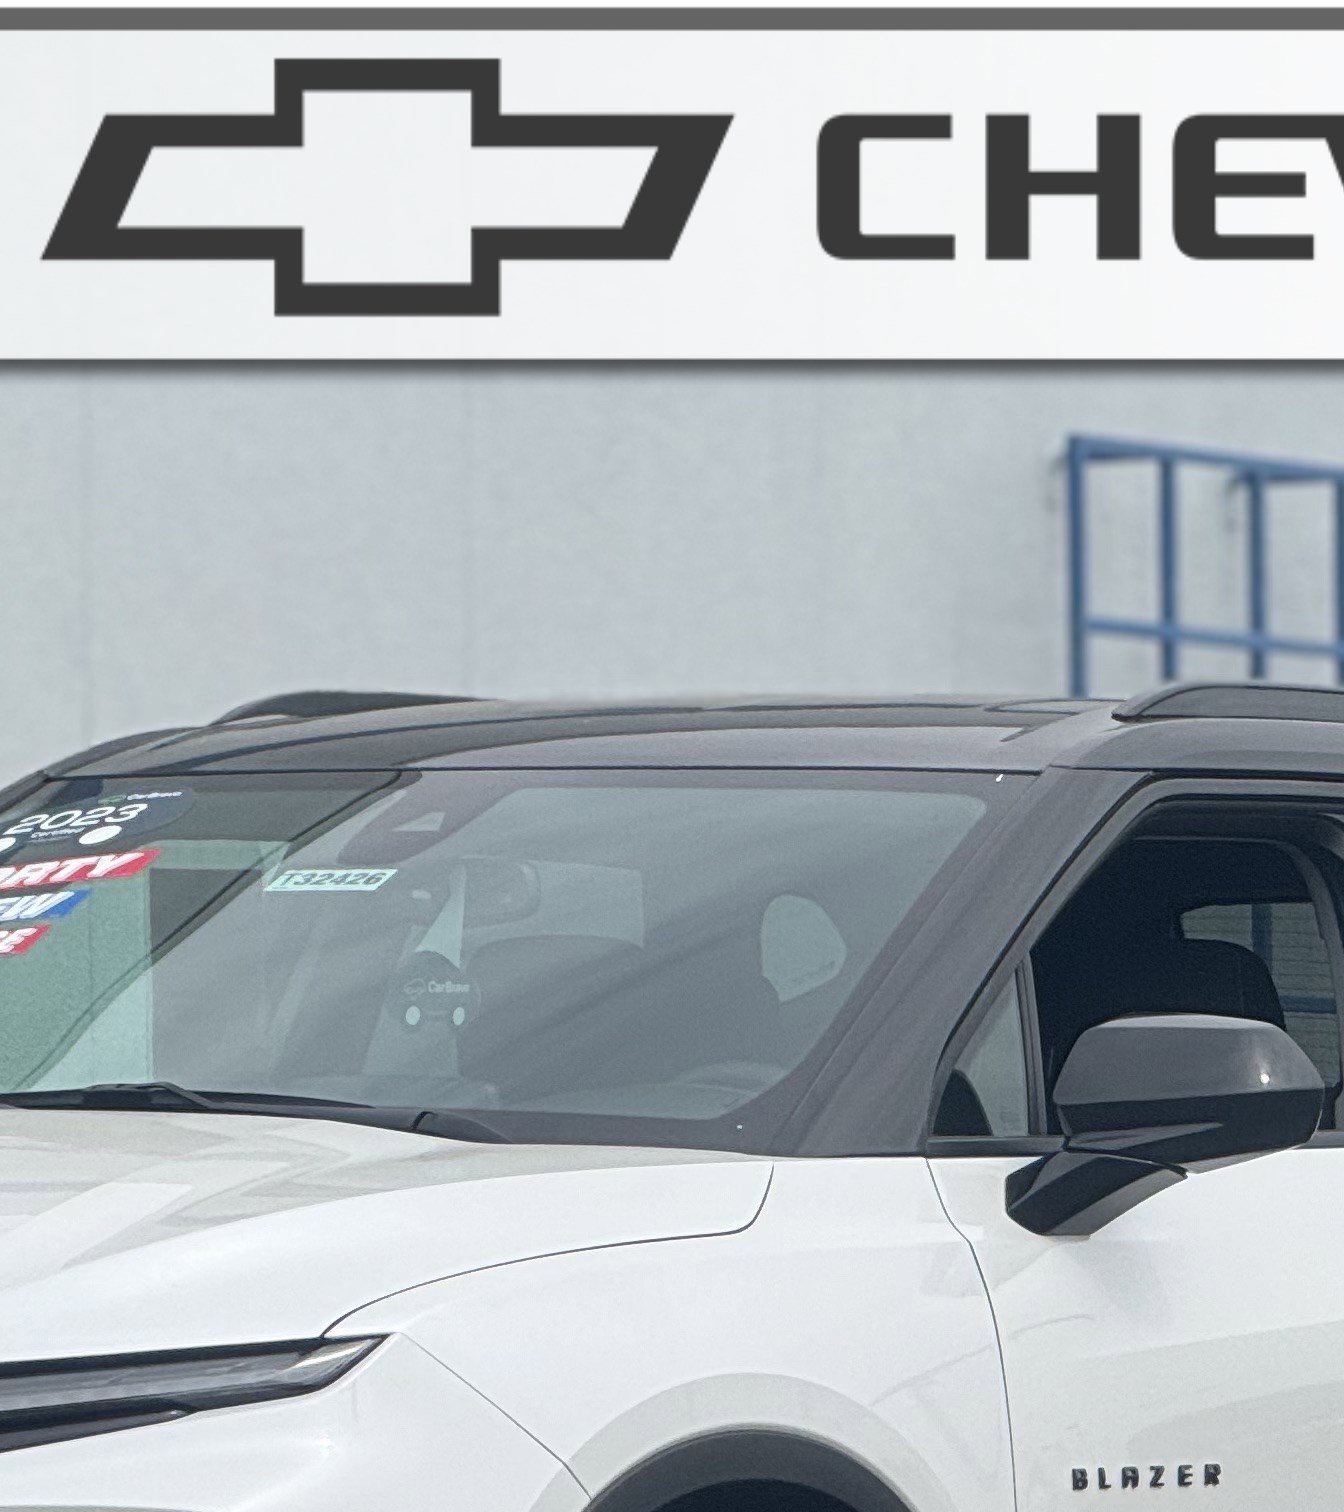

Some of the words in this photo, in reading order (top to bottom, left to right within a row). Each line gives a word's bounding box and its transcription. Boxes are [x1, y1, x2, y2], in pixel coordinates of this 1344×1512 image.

[3, 803, 148, 835] 2023
[280, 872, 385, 886] T32426
[1071, 1463, 1222, 1491] BLAZER
